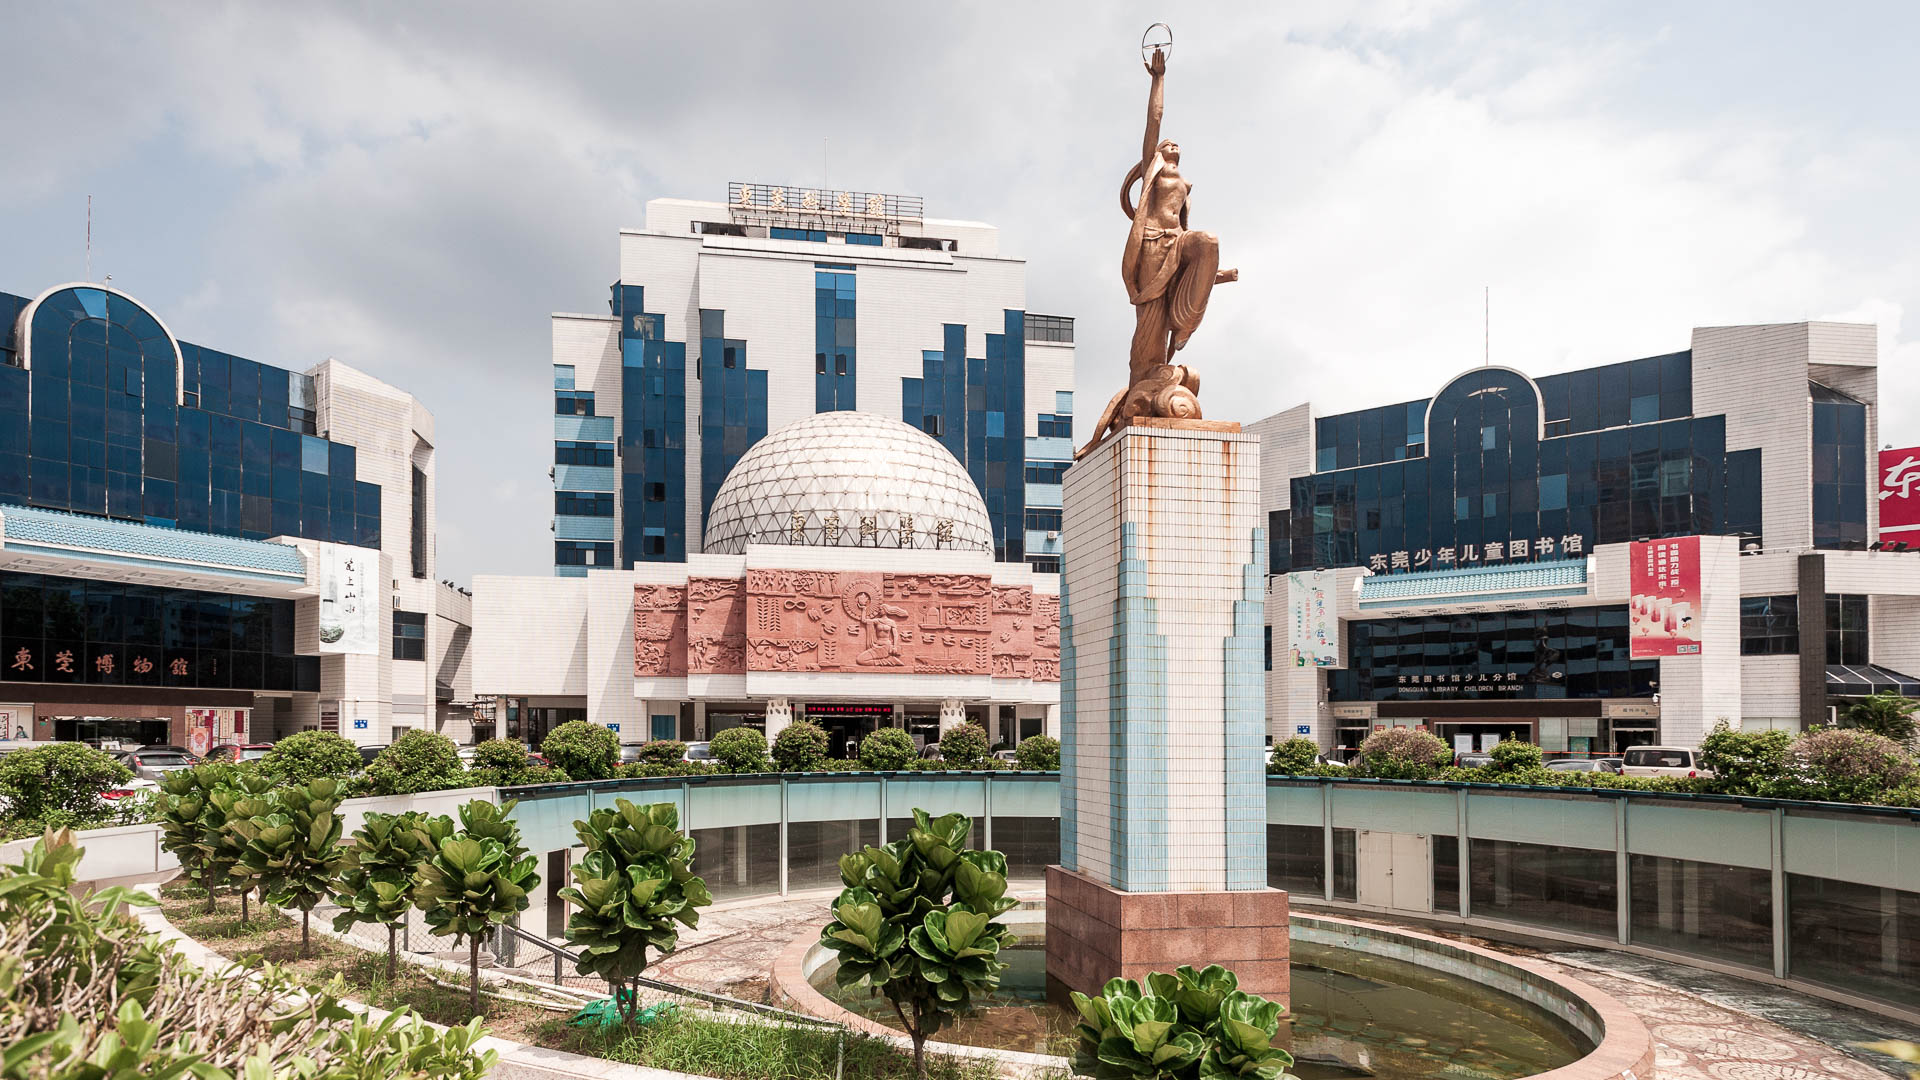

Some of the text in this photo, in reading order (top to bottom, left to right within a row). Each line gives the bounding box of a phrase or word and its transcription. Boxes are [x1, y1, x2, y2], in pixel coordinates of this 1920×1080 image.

[1370, 533, 1583, 570] 东莞少年儿童图书馆
[344, 558, 356, 614] 瓷上山水
[1398, 672, 1517, 684] 东莞图书馆少儿分馆
[1398, 686, 1429, 694] DONGGUAN
